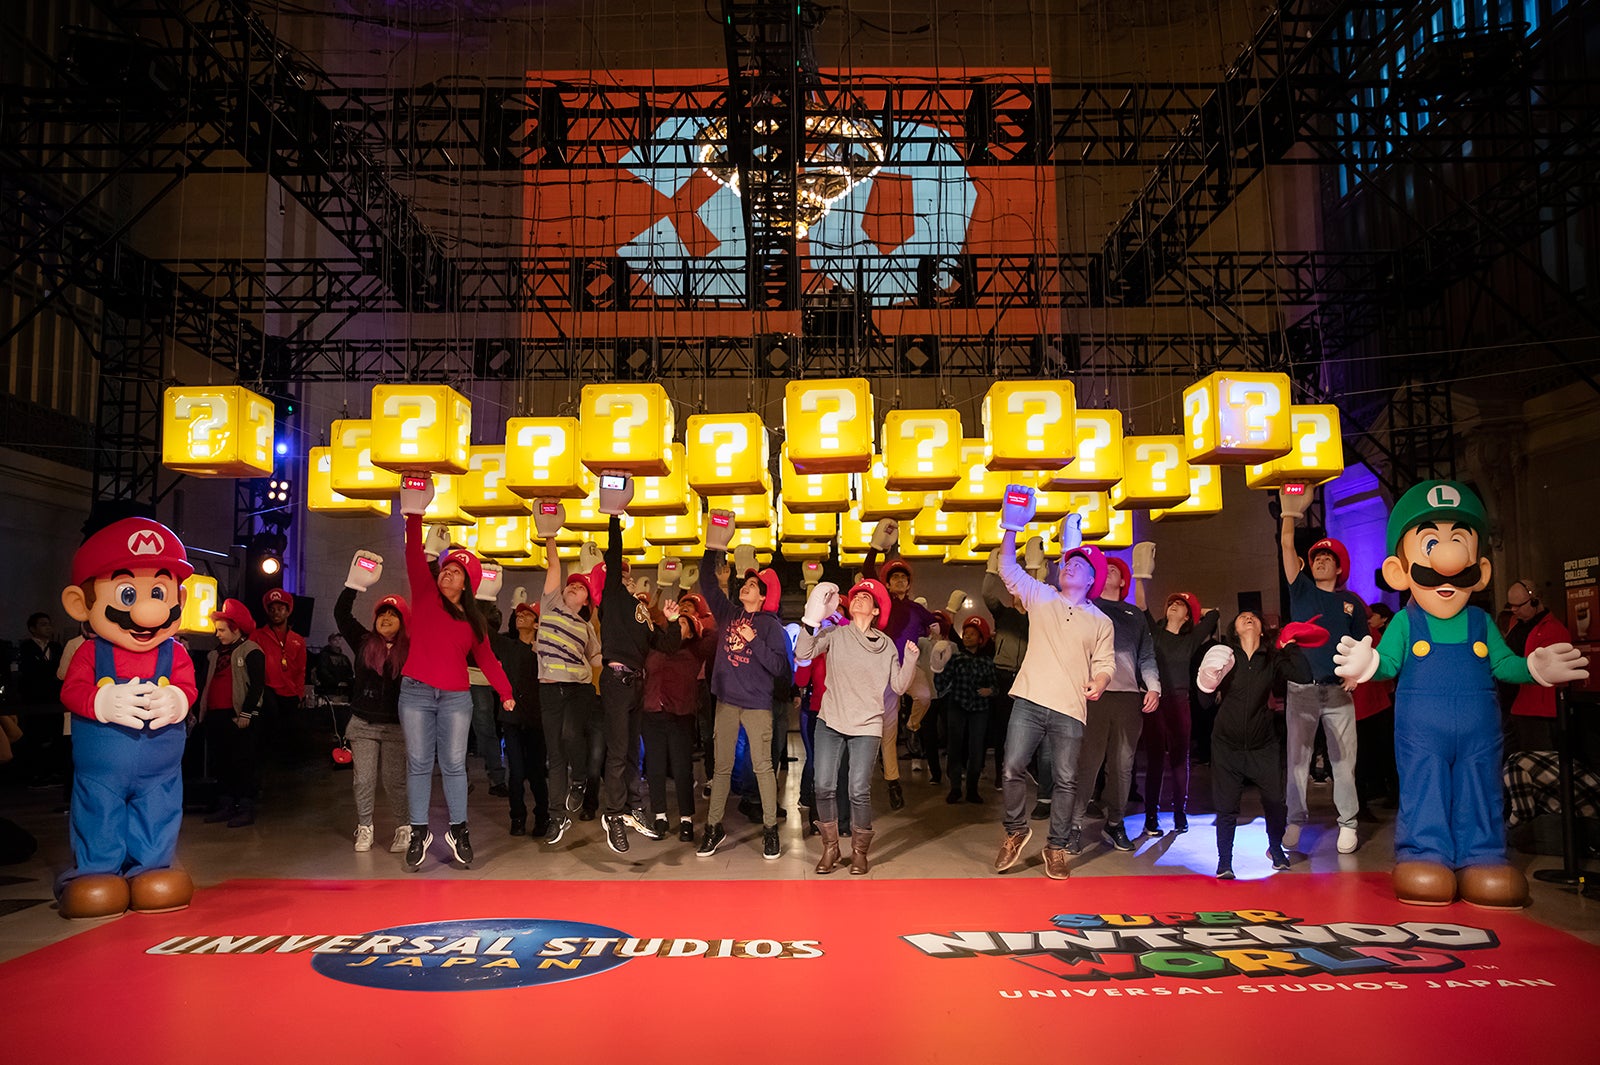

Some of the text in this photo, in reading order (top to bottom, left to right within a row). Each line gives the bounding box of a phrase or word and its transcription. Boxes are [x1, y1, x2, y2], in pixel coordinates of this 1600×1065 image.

[1435, 487, 1454, 505] L
[129, 533, 163, 554] M
[1048, 909, 1303, 928] SUPER
[146, 934, 825, 958] UNIVERSAL STUDIOS
[898, 921, 1500, 957] NINTENDO
[346, 956, 582, 970] JAPAN
[1008, 946, 1465, 981] WORLD
[1000, 978, 1556, 999] UNIVERSAL STUDIOS JAPAN
